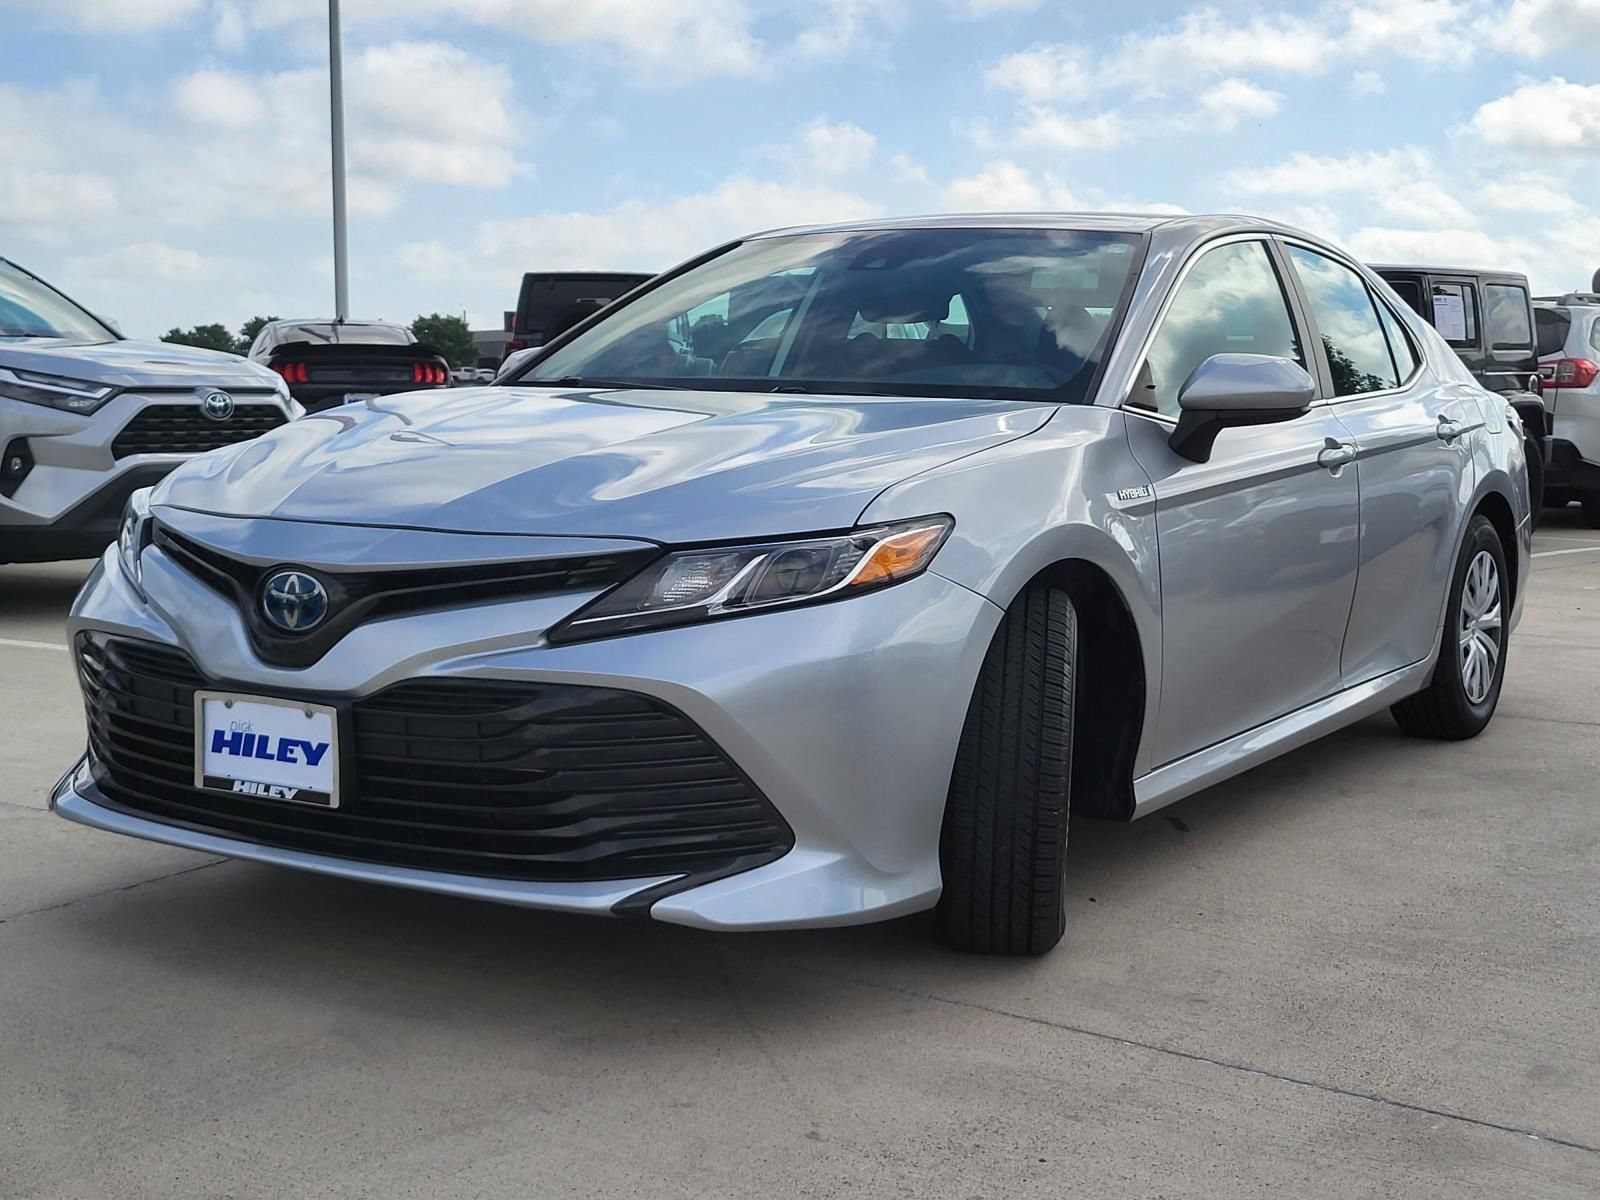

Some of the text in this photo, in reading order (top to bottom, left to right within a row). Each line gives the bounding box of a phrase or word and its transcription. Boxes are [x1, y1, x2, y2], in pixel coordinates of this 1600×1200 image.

[1118, 486, 1149, 500] HYBRID
[211, 729, 329, 766] HILEY
[233, 780, 299, 799] HILEY
